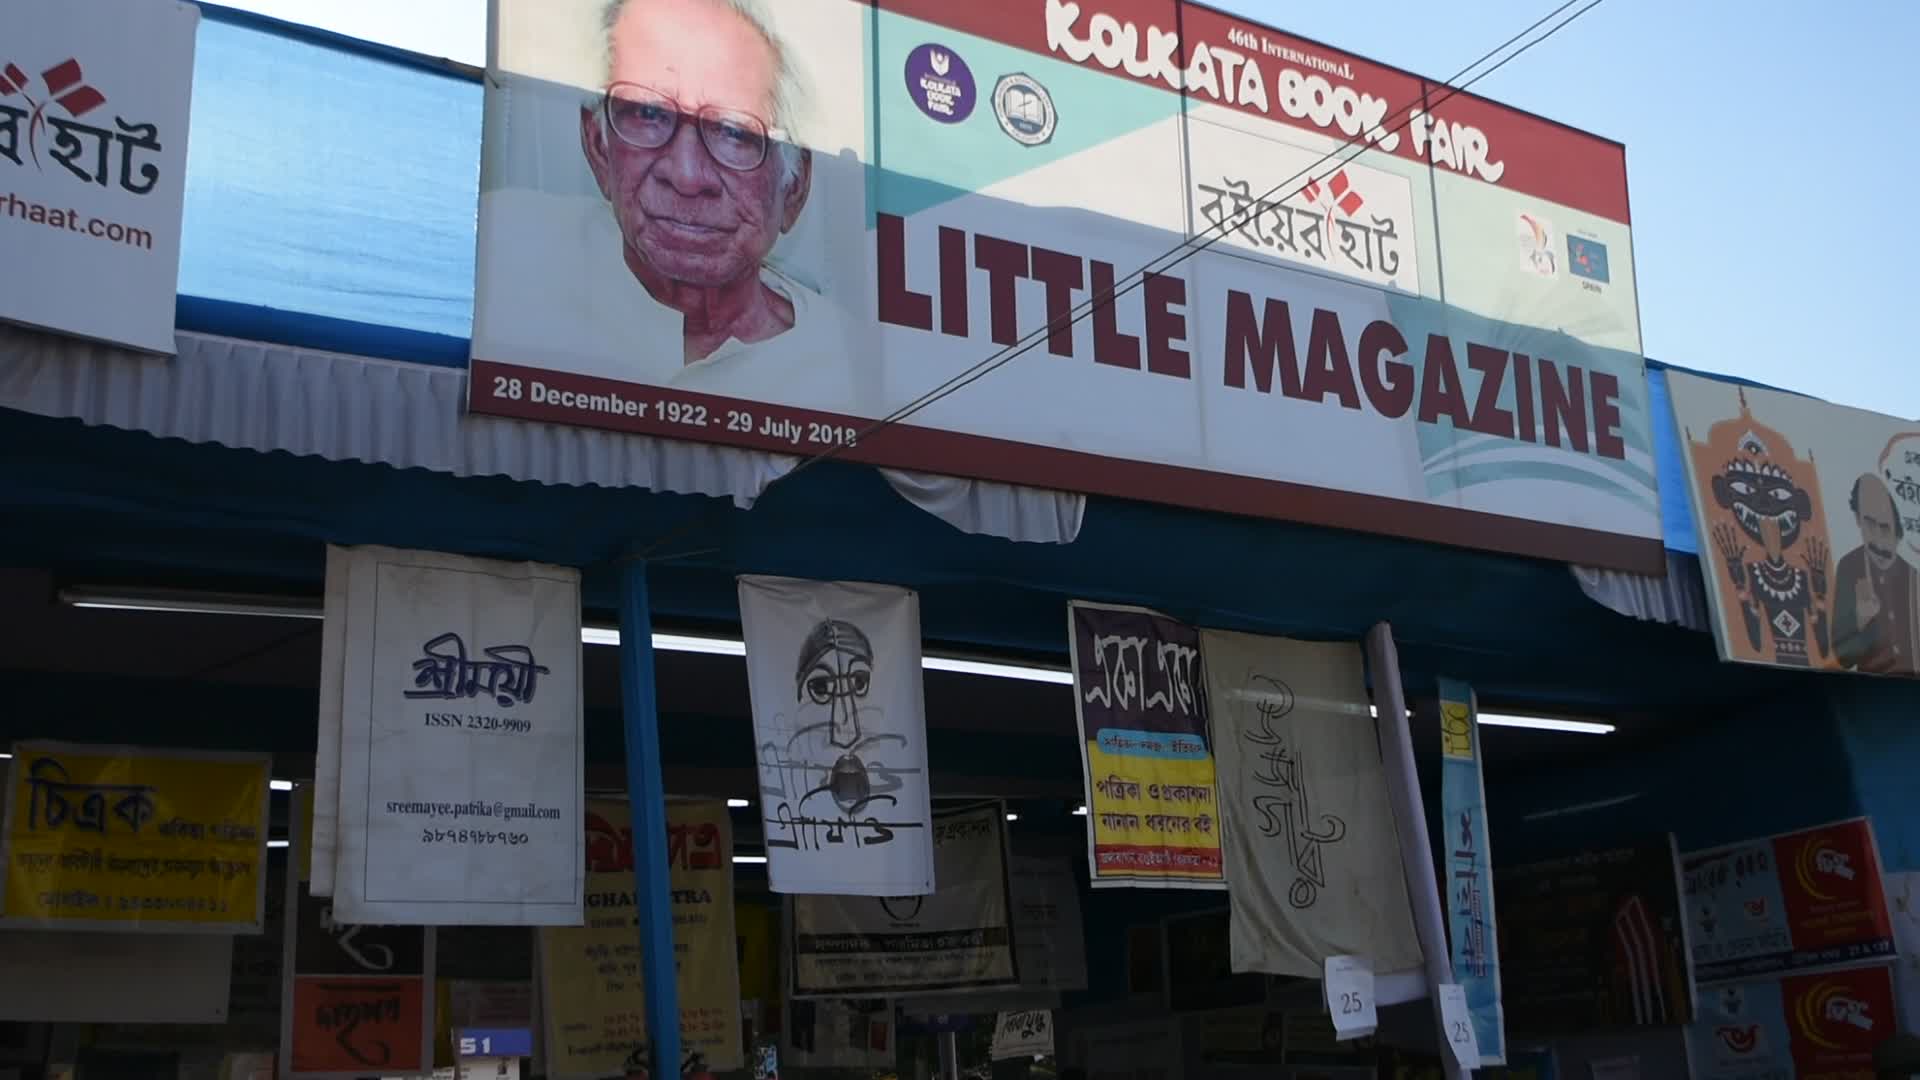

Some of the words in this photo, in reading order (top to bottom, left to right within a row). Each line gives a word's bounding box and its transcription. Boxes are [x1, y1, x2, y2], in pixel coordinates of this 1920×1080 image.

[1227, 27, 1258, 50] 46th
[1261, 37, 1355, 81] INTERNATIONAL
[1045, 0, 1268, 113] KOLKATA
[1278, 67, 1400, 153] BOOK
[1408, 107, 1504, 183] FAIR
[47, 115, 162, 195] হাট
[1338, 215, 1399, 277] হাট
[876, 211, 1191, 380] LITTLE
[1223, 288, 1626, 461] MAGAZINE
[493, 376, 522, 400] 28
[530, 381, 648, 418] December
[655, 401, 707, 427] 1922
[727, 411, 753, 432] 29
[760, 416, 802, 444] July
[808, 423, 858, 449] 2018
[424, 712, 464, 728] ISSN
[467, 715, 532, 732] 2320-9909
[1096, 771, 1142, 802] পত্রিকা
[386, 799, 561, 822] sreemayee.patrika@gmail.com
[422, 828, 529, 846] ৯৮৭৪৭৮৮৭৬০
[1340, 991, 1363, 1015] 25
[1454, 1021, 1471, 1044] 25
